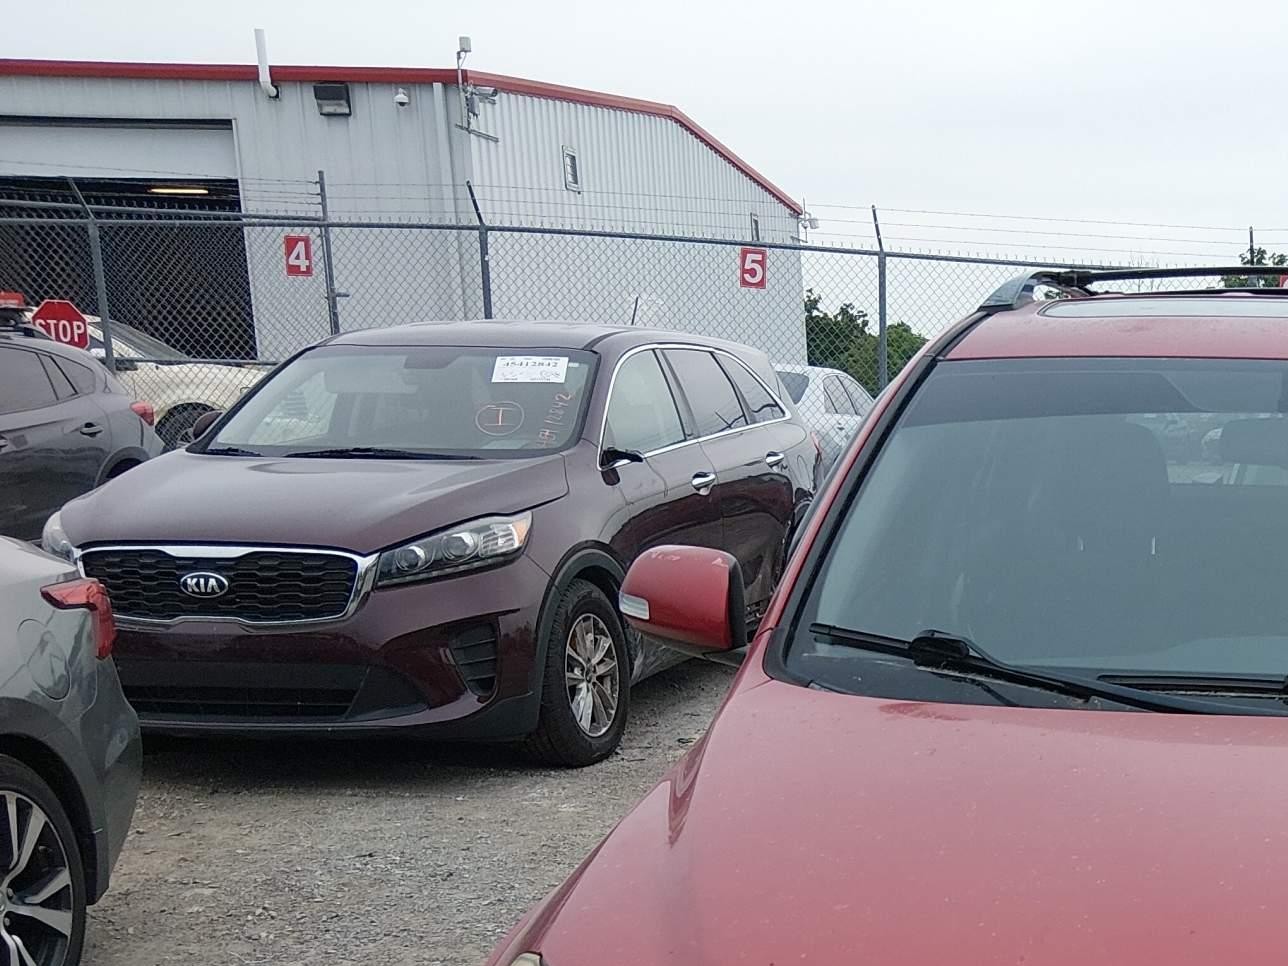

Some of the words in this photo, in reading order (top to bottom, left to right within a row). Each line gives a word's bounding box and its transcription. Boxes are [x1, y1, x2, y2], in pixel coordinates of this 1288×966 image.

[289, 241, 310, 271] 4
[744, 253, 763, 283] 5
[186, 577, 221, 593] KIA
